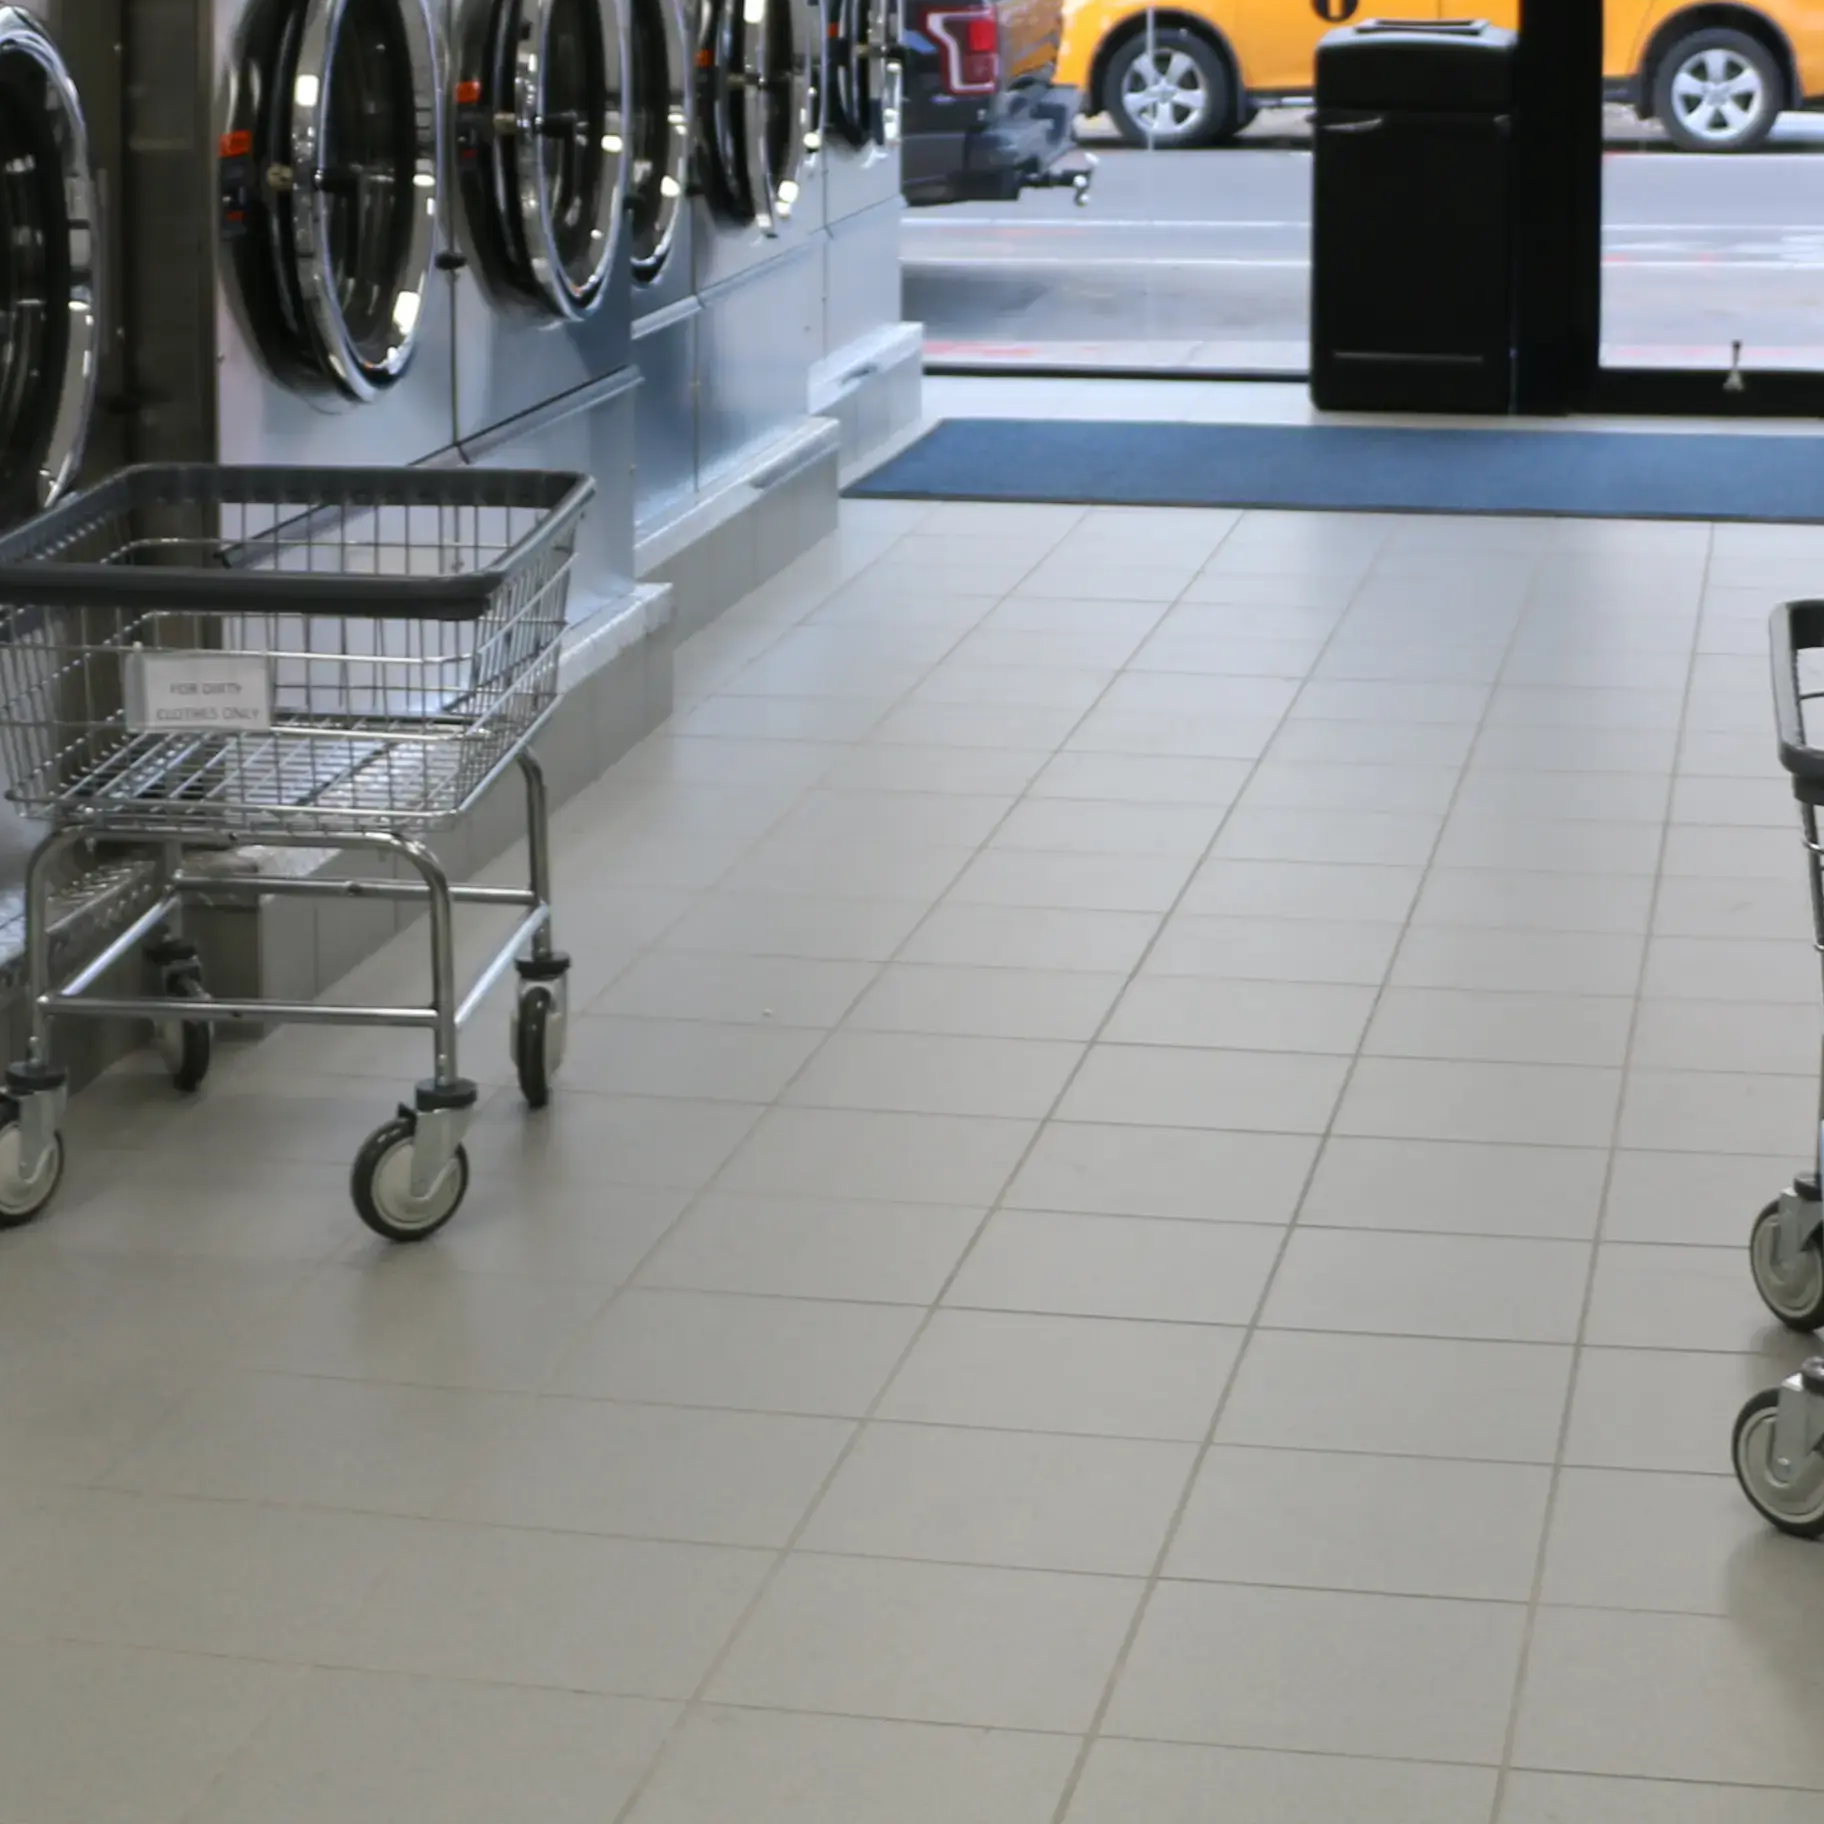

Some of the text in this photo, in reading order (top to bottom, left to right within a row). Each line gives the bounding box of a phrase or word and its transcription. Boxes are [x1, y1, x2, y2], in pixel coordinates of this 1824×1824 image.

[170, 683, 242, 695] FOR DIRTY
[156, 707, 260, 720] CLOTHES ONLY
